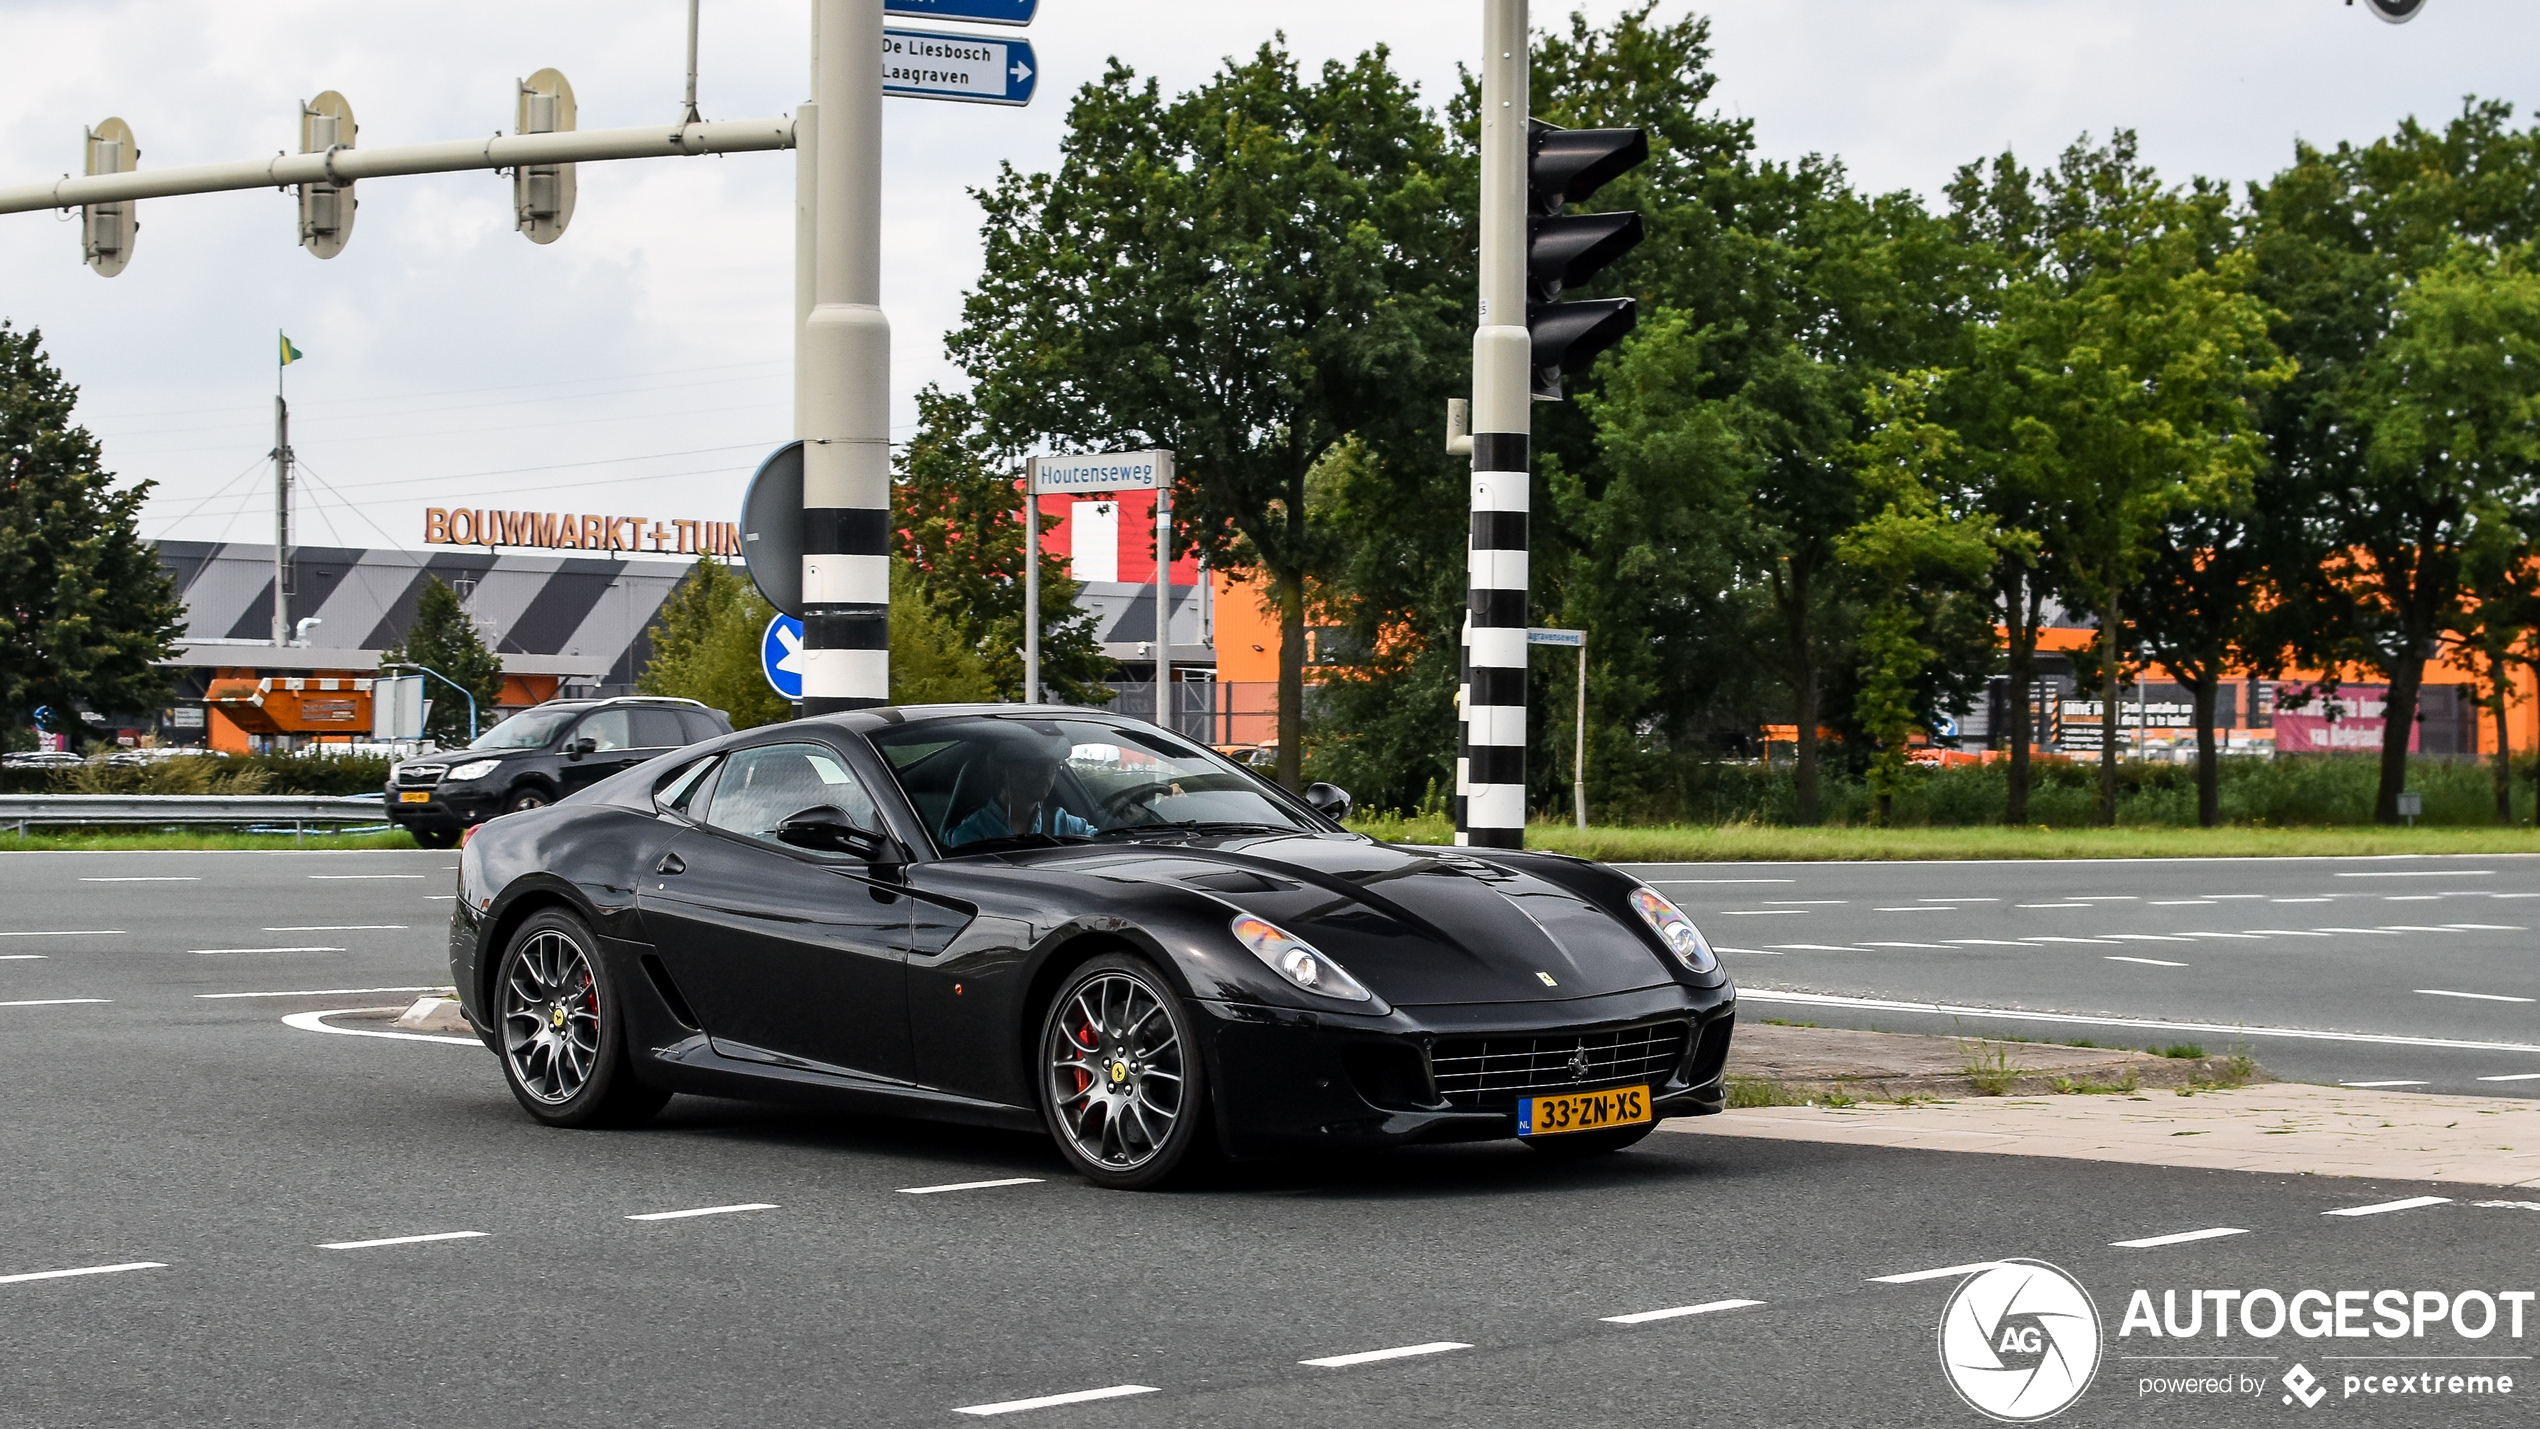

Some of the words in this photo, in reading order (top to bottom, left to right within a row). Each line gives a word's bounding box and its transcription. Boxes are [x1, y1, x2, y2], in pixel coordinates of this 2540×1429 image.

[882, 38, 902, 54] De
[909, 41, 991, 61] Liesbosch
[882, 64, 969, 85] Laagraven
[1041, 464, 1152, 485] Houtenseweg
[1519, 1120, 1530, 1129] NL
[1541, 1091, 1642, 1128] 33-ZN-XS
